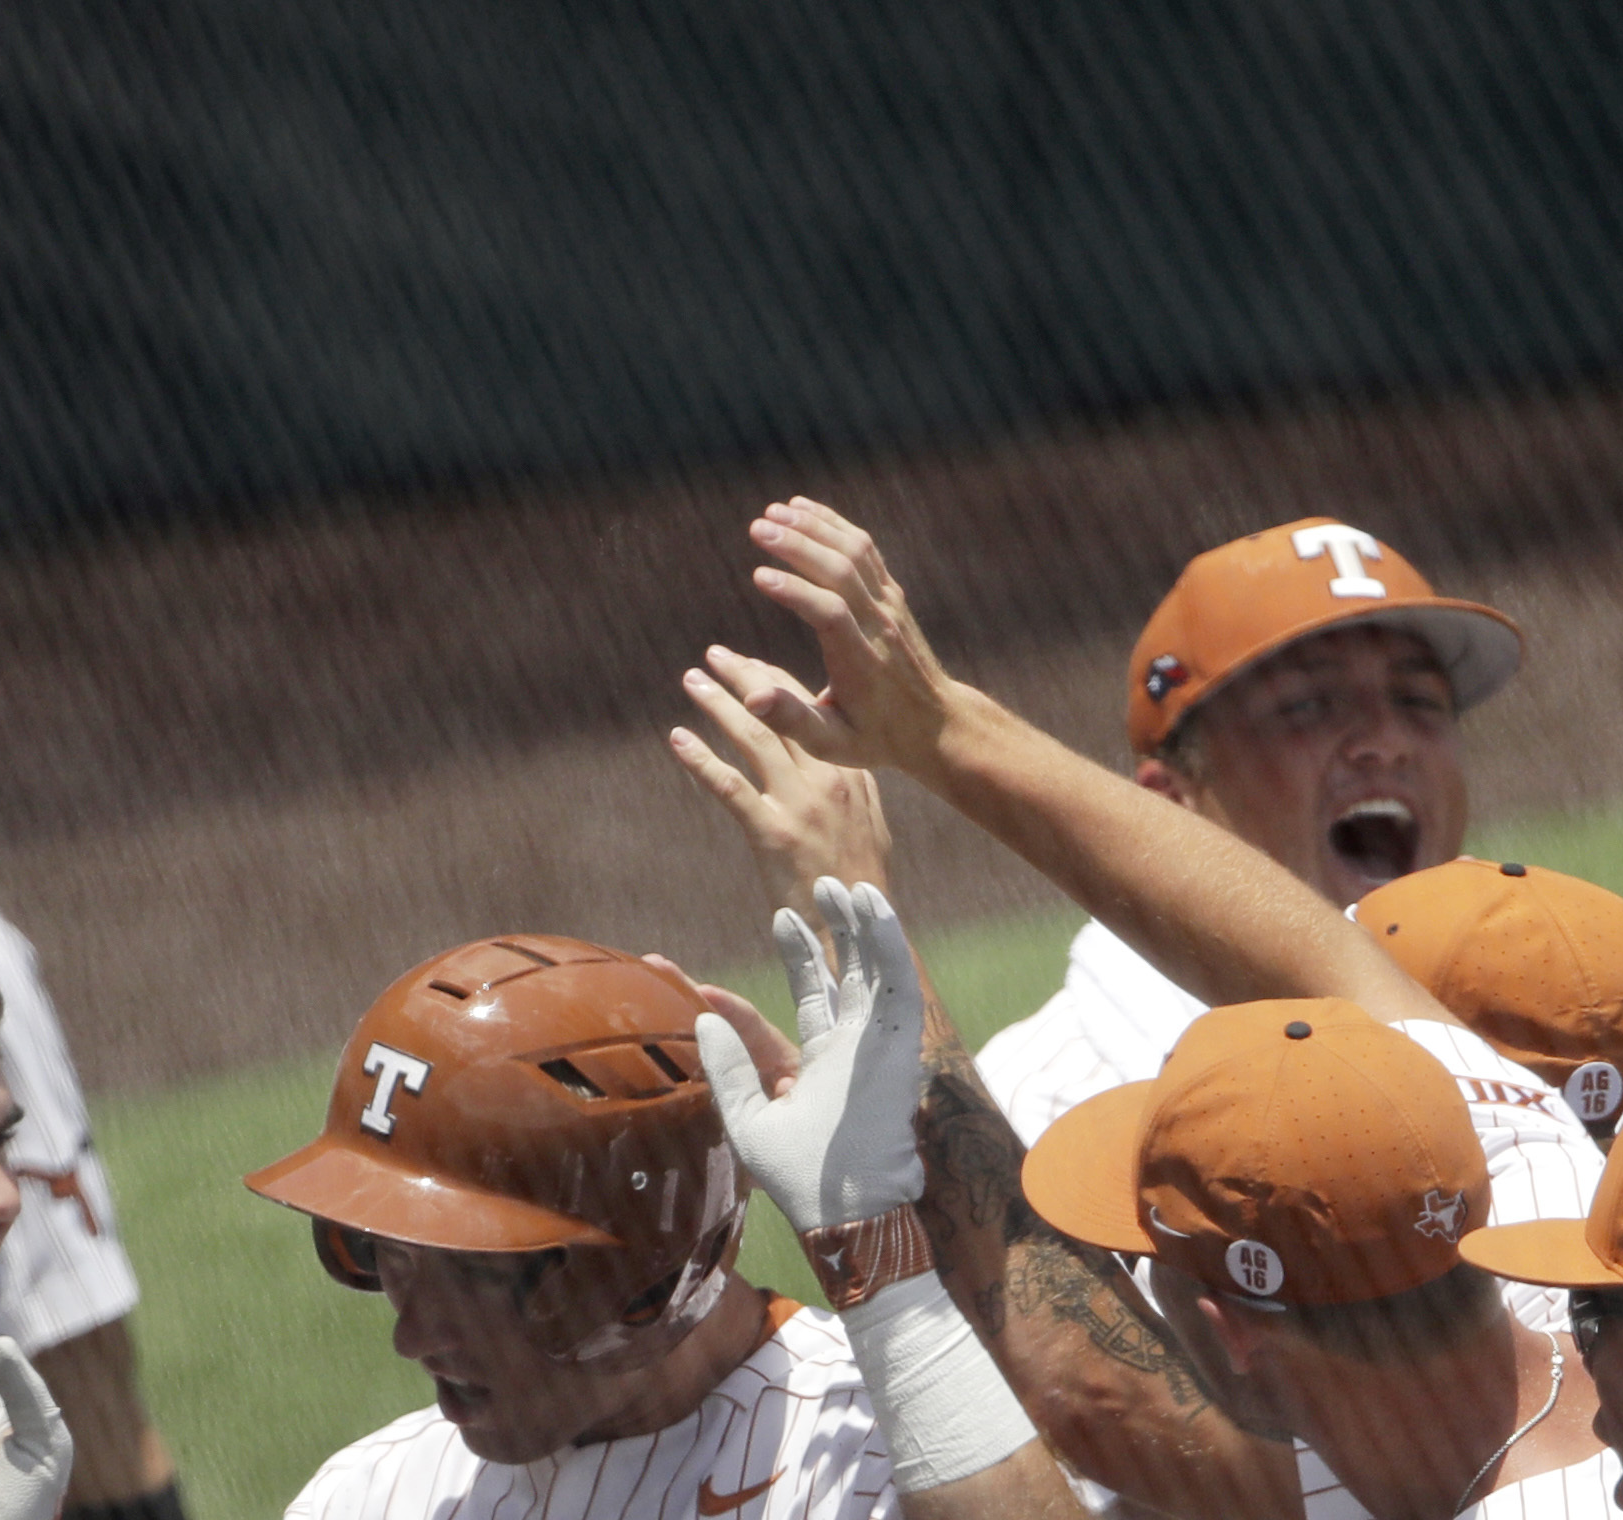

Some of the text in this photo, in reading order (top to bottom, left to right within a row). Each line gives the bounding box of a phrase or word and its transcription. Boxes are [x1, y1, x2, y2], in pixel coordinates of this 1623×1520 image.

[1291, 523, 1388, 600] T
[361, 1042, 432, 1137] T
[1583, 1093, 1607, 1115] 16
[1240, 1246, 1269, 1271] AG
[1242, 1268, 1267, 1291] 16
